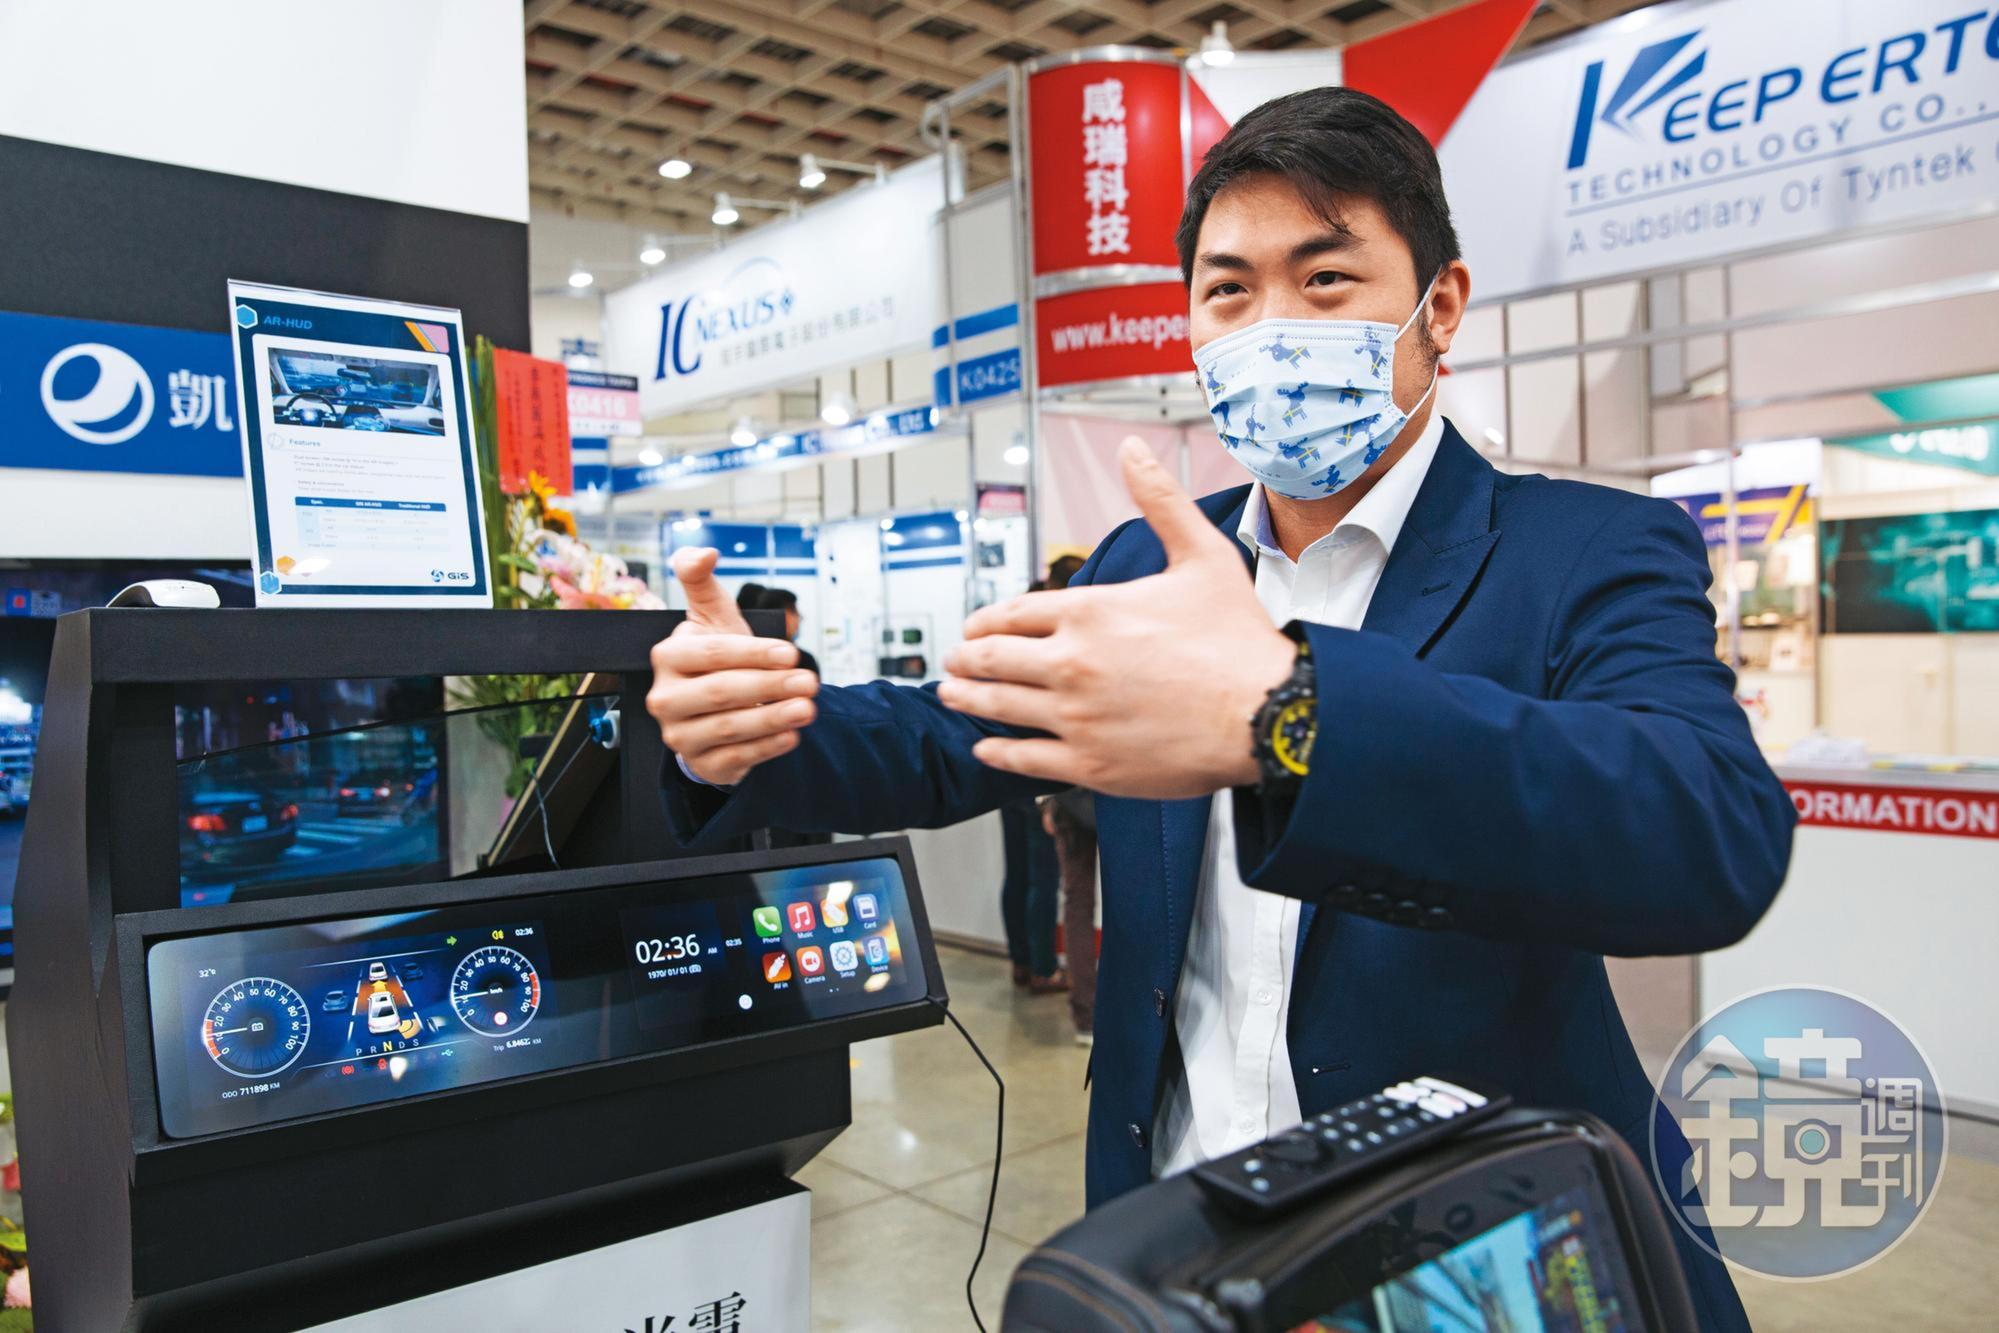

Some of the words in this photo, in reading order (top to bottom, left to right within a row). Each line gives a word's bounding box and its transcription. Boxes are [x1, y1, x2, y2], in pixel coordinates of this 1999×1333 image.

[1566, 117, 1852, 204] TECHNOLOGY
[1567, 230, 1587, 257] A
[1600, 192, 1766, 252] Subsidiary
[1780, 176, 1825, 213] Of
[1843, 143, 1976, 203] Tyntek
[263, 315, 313, 330] AR-HUD
[168, 368, 234, 432] 凱
[289, 438, 321, 447] Features
[864, 921, 877, 930] Card
[762, 936, 780, 944] Phone
[797, 931, 814, 939] Music
[635, 933, 701, 965] 02:36
[707, 946, 718, 955] AM
[474, 958, 485, 968] 40
[488, 956, 497, 964] 50
[500, 956, 511, 965] 60
[512, 962, 521, 972] 70
[465, 968, 474, 978] 30
[520, 972, 530, 983] 80
[460, 980, 469, 991] 20
[804, 976, 826, 985] Camera
[249, 988, 259, 996] 50
[264, 988, 276, 998] 60
[524, 987, 532, 995] 90
[233, 991, 245, 1002] 40
[278, 994, 288, 1005] 70
[221, 1002, 232, 1013] 30
[520, 998, 532, 1013] 100
[287, 1005, 298, 1017] 80
[467, 1008, 475, 1017] 0
[214, 1015, 225, 1027] 20
[291, 1021, 299, 1031] 90
[285, 1034, 299, 1050] 100
[355, 1048, 362, 1056] P
[370, 1045, 377, 1054] R
[382, 1040, 393, 1052] N
[398, 1041, 405, 1049] D
[412, 1038, 419, 1047] S
[221, 1047, 230, 1055] 0
[493, 1044, 504, 1053] Trip
[240, 1084, 269, 1096] 711898
[269, 1082, 280, 1090] KM
